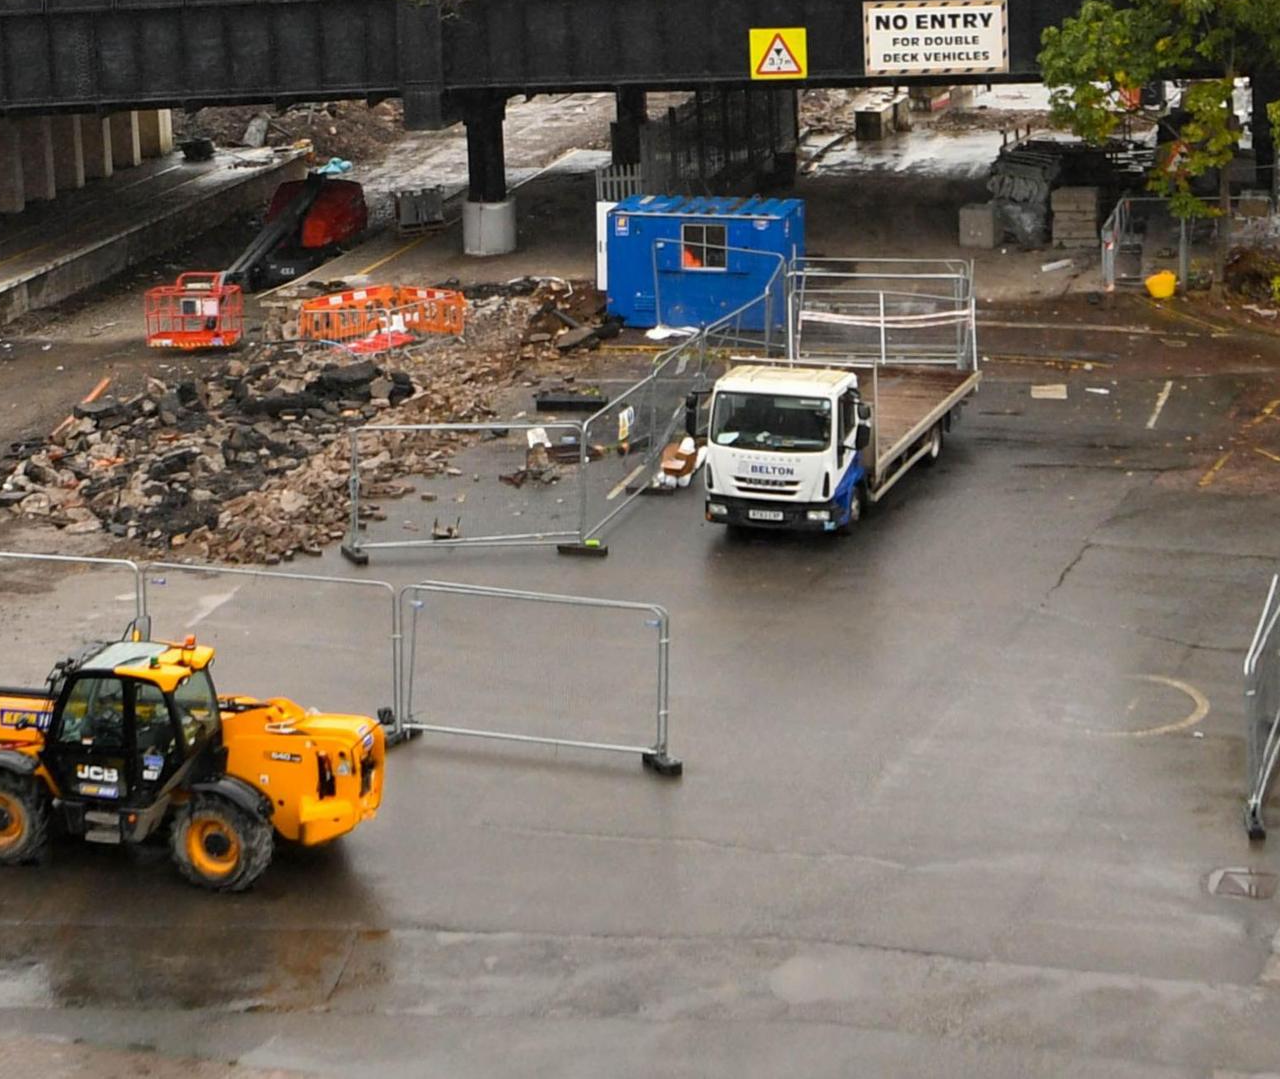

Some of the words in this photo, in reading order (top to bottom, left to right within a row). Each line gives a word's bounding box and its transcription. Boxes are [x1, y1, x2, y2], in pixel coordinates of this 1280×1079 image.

[875, 14, 908, 30] NO
[916, 12, 993, 29] ENTRY
[892, 36, 919, 47] FOR
[924, 35, 980, 46] DOUBLE
[882, 52, 919, 63] DECK
[924, 51, 990, 62] VEHICLES
[751, 464, 794, 475] BELTON
[76, 764, 118, 782] JCB
